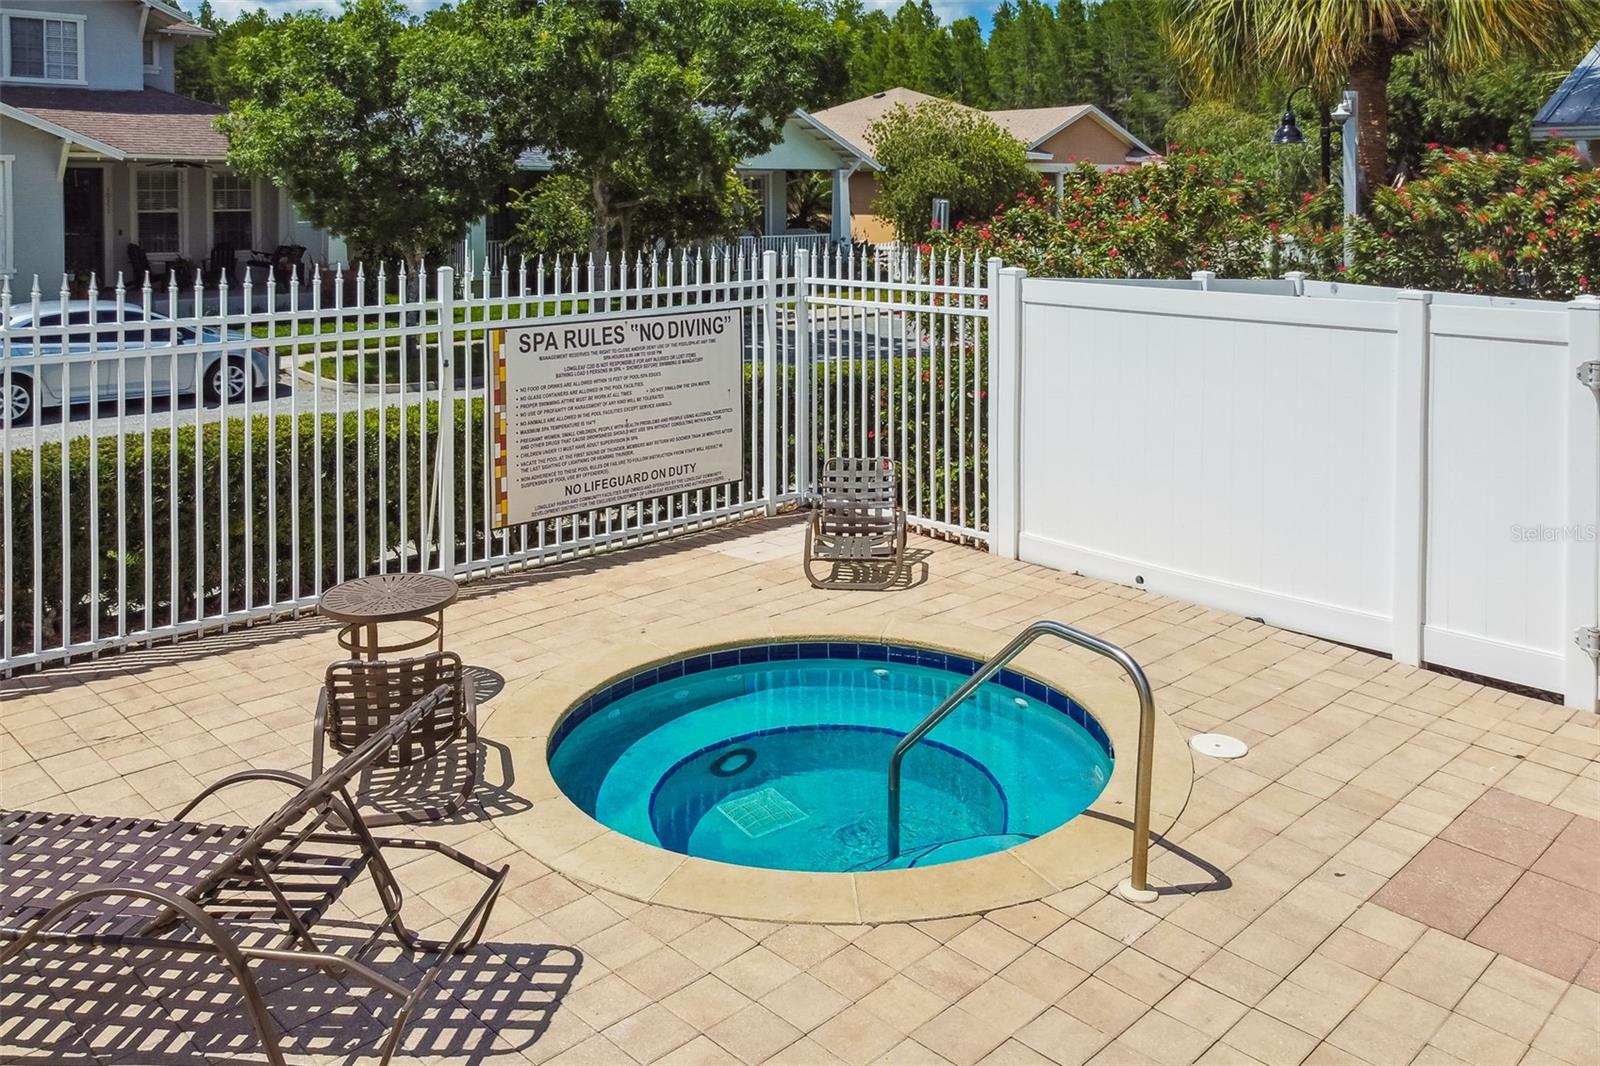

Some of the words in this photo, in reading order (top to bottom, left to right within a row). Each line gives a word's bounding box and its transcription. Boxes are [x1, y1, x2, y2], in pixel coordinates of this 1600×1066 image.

[519, 331, 558, 353] SPA
[564, 325, 624, 349] RULES
[565, 483, 581, 496] NO
[585, 471, 648, 493] LIFEGUARD
[651, 468, 666, 481] ON
[669, 463, 696, 477] DUTY
